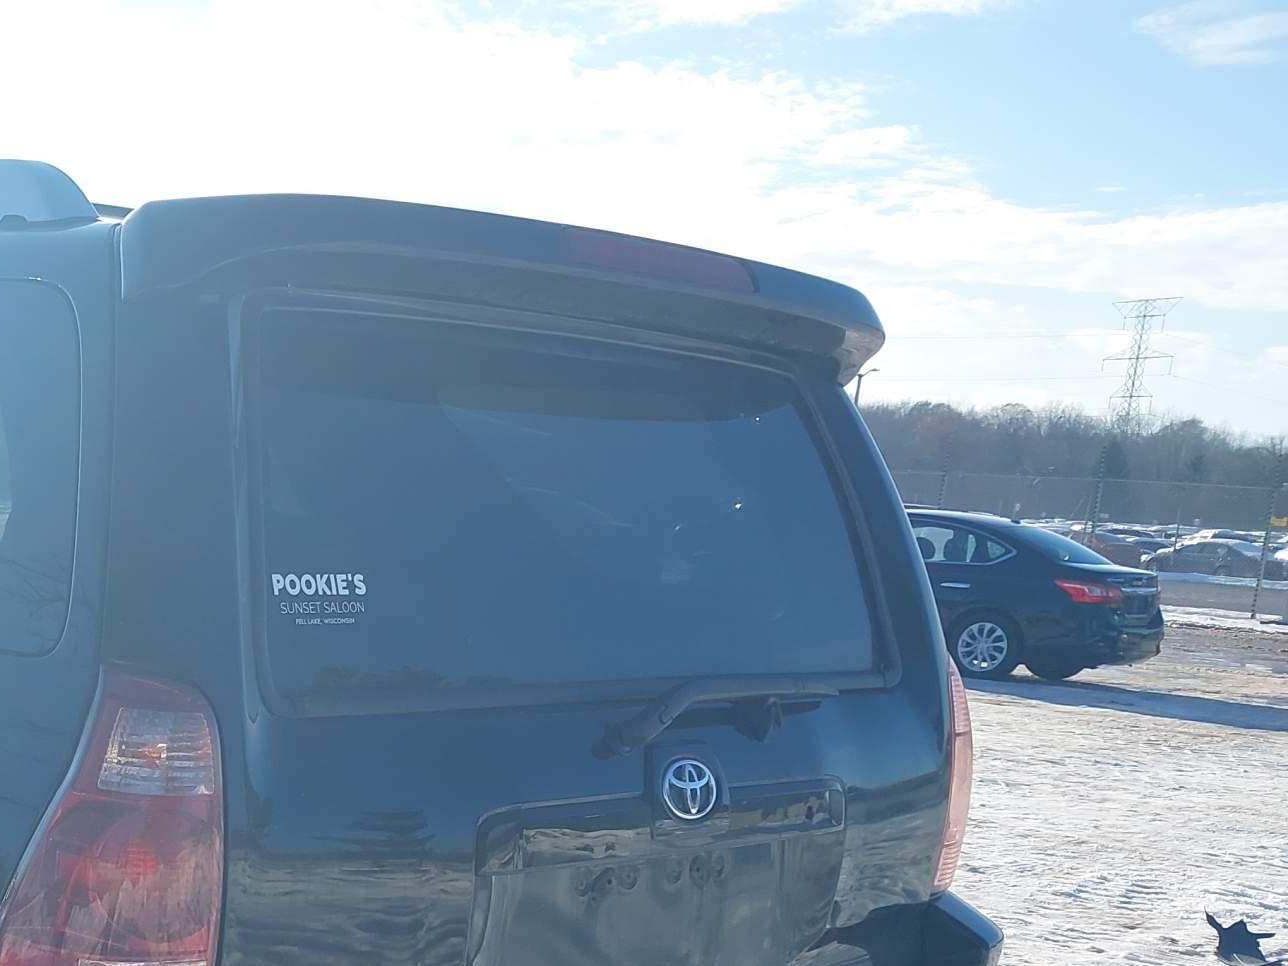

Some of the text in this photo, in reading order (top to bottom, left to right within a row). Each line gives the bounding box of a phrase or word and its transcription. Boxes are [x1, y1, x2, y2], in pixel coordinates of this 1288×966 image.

[271, 573, 367, 596] POOKIE'S
[280, 601, 365, 615] SUNSET SALOON
